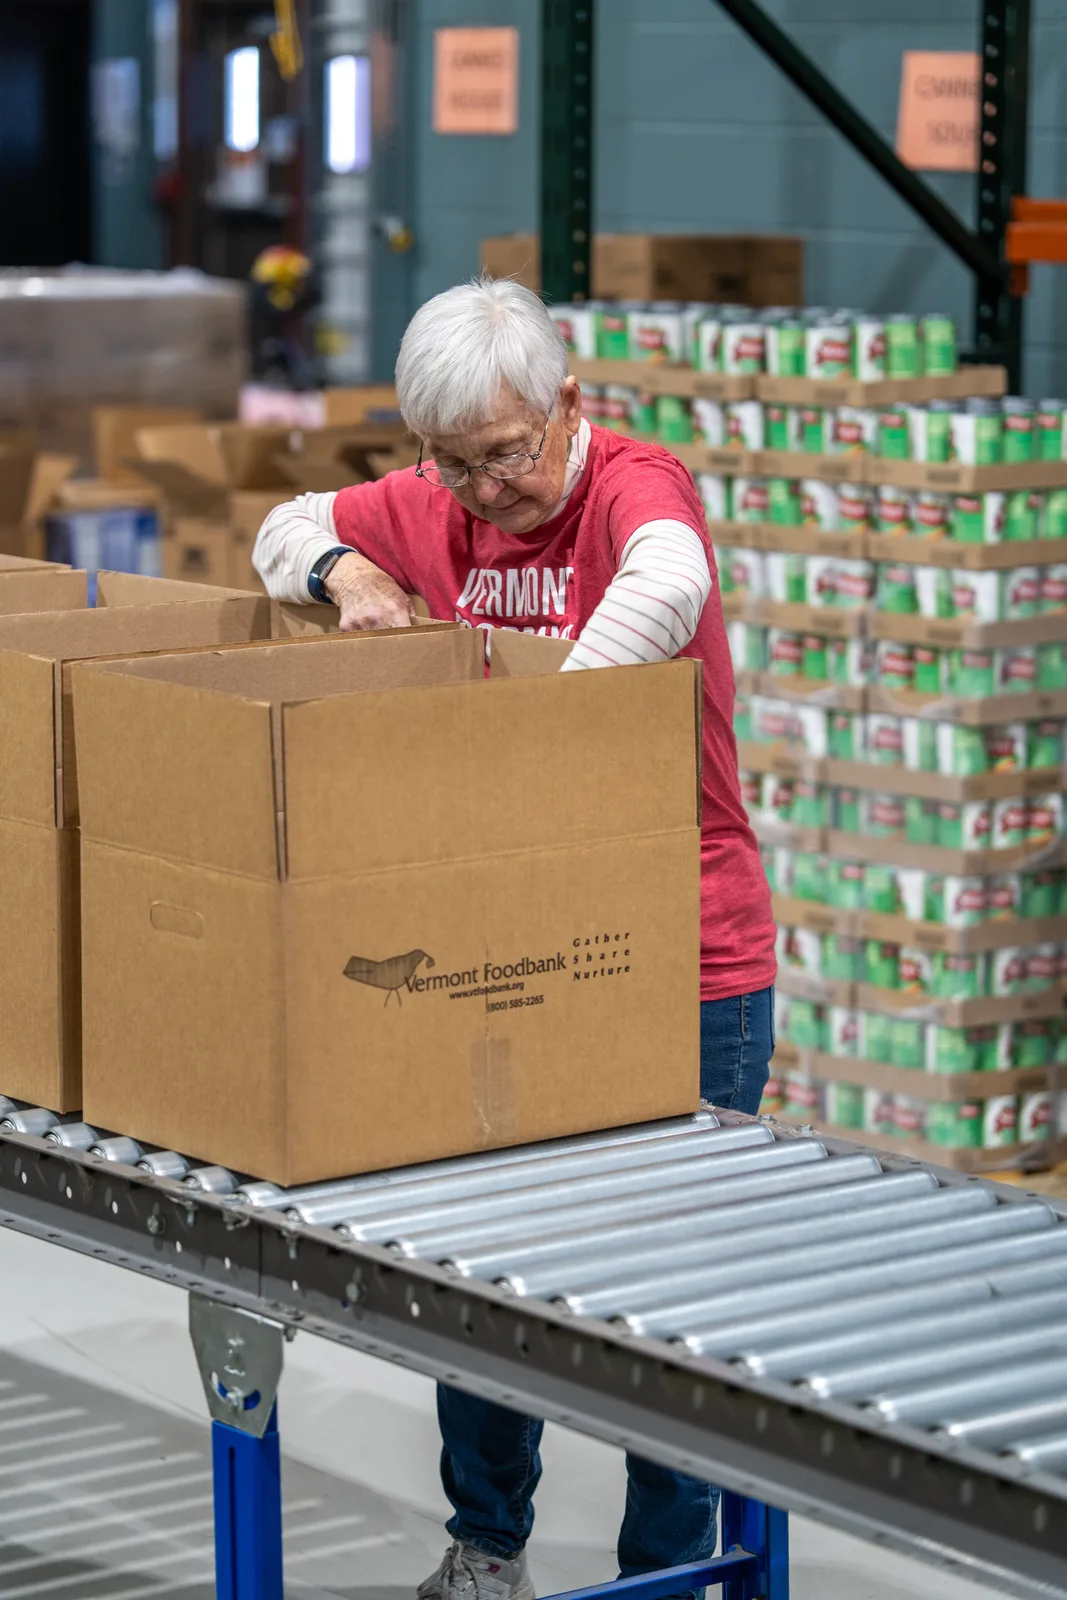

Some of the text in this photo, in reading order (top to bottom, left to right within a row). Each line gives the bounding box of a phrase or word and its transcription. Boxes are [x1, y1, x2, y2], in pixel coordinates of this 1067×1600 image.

[573, 932, 630, 948] Gather
[573, 949, 630, 964] Share
[404, 952, 567, 993] Vermont Foodbank
[573, 965, 630, 982] Nurture
[449, 981, 524, 999] www.vtfoodbank.org
[487, 994, 544, 1013] (800) 585-2265
